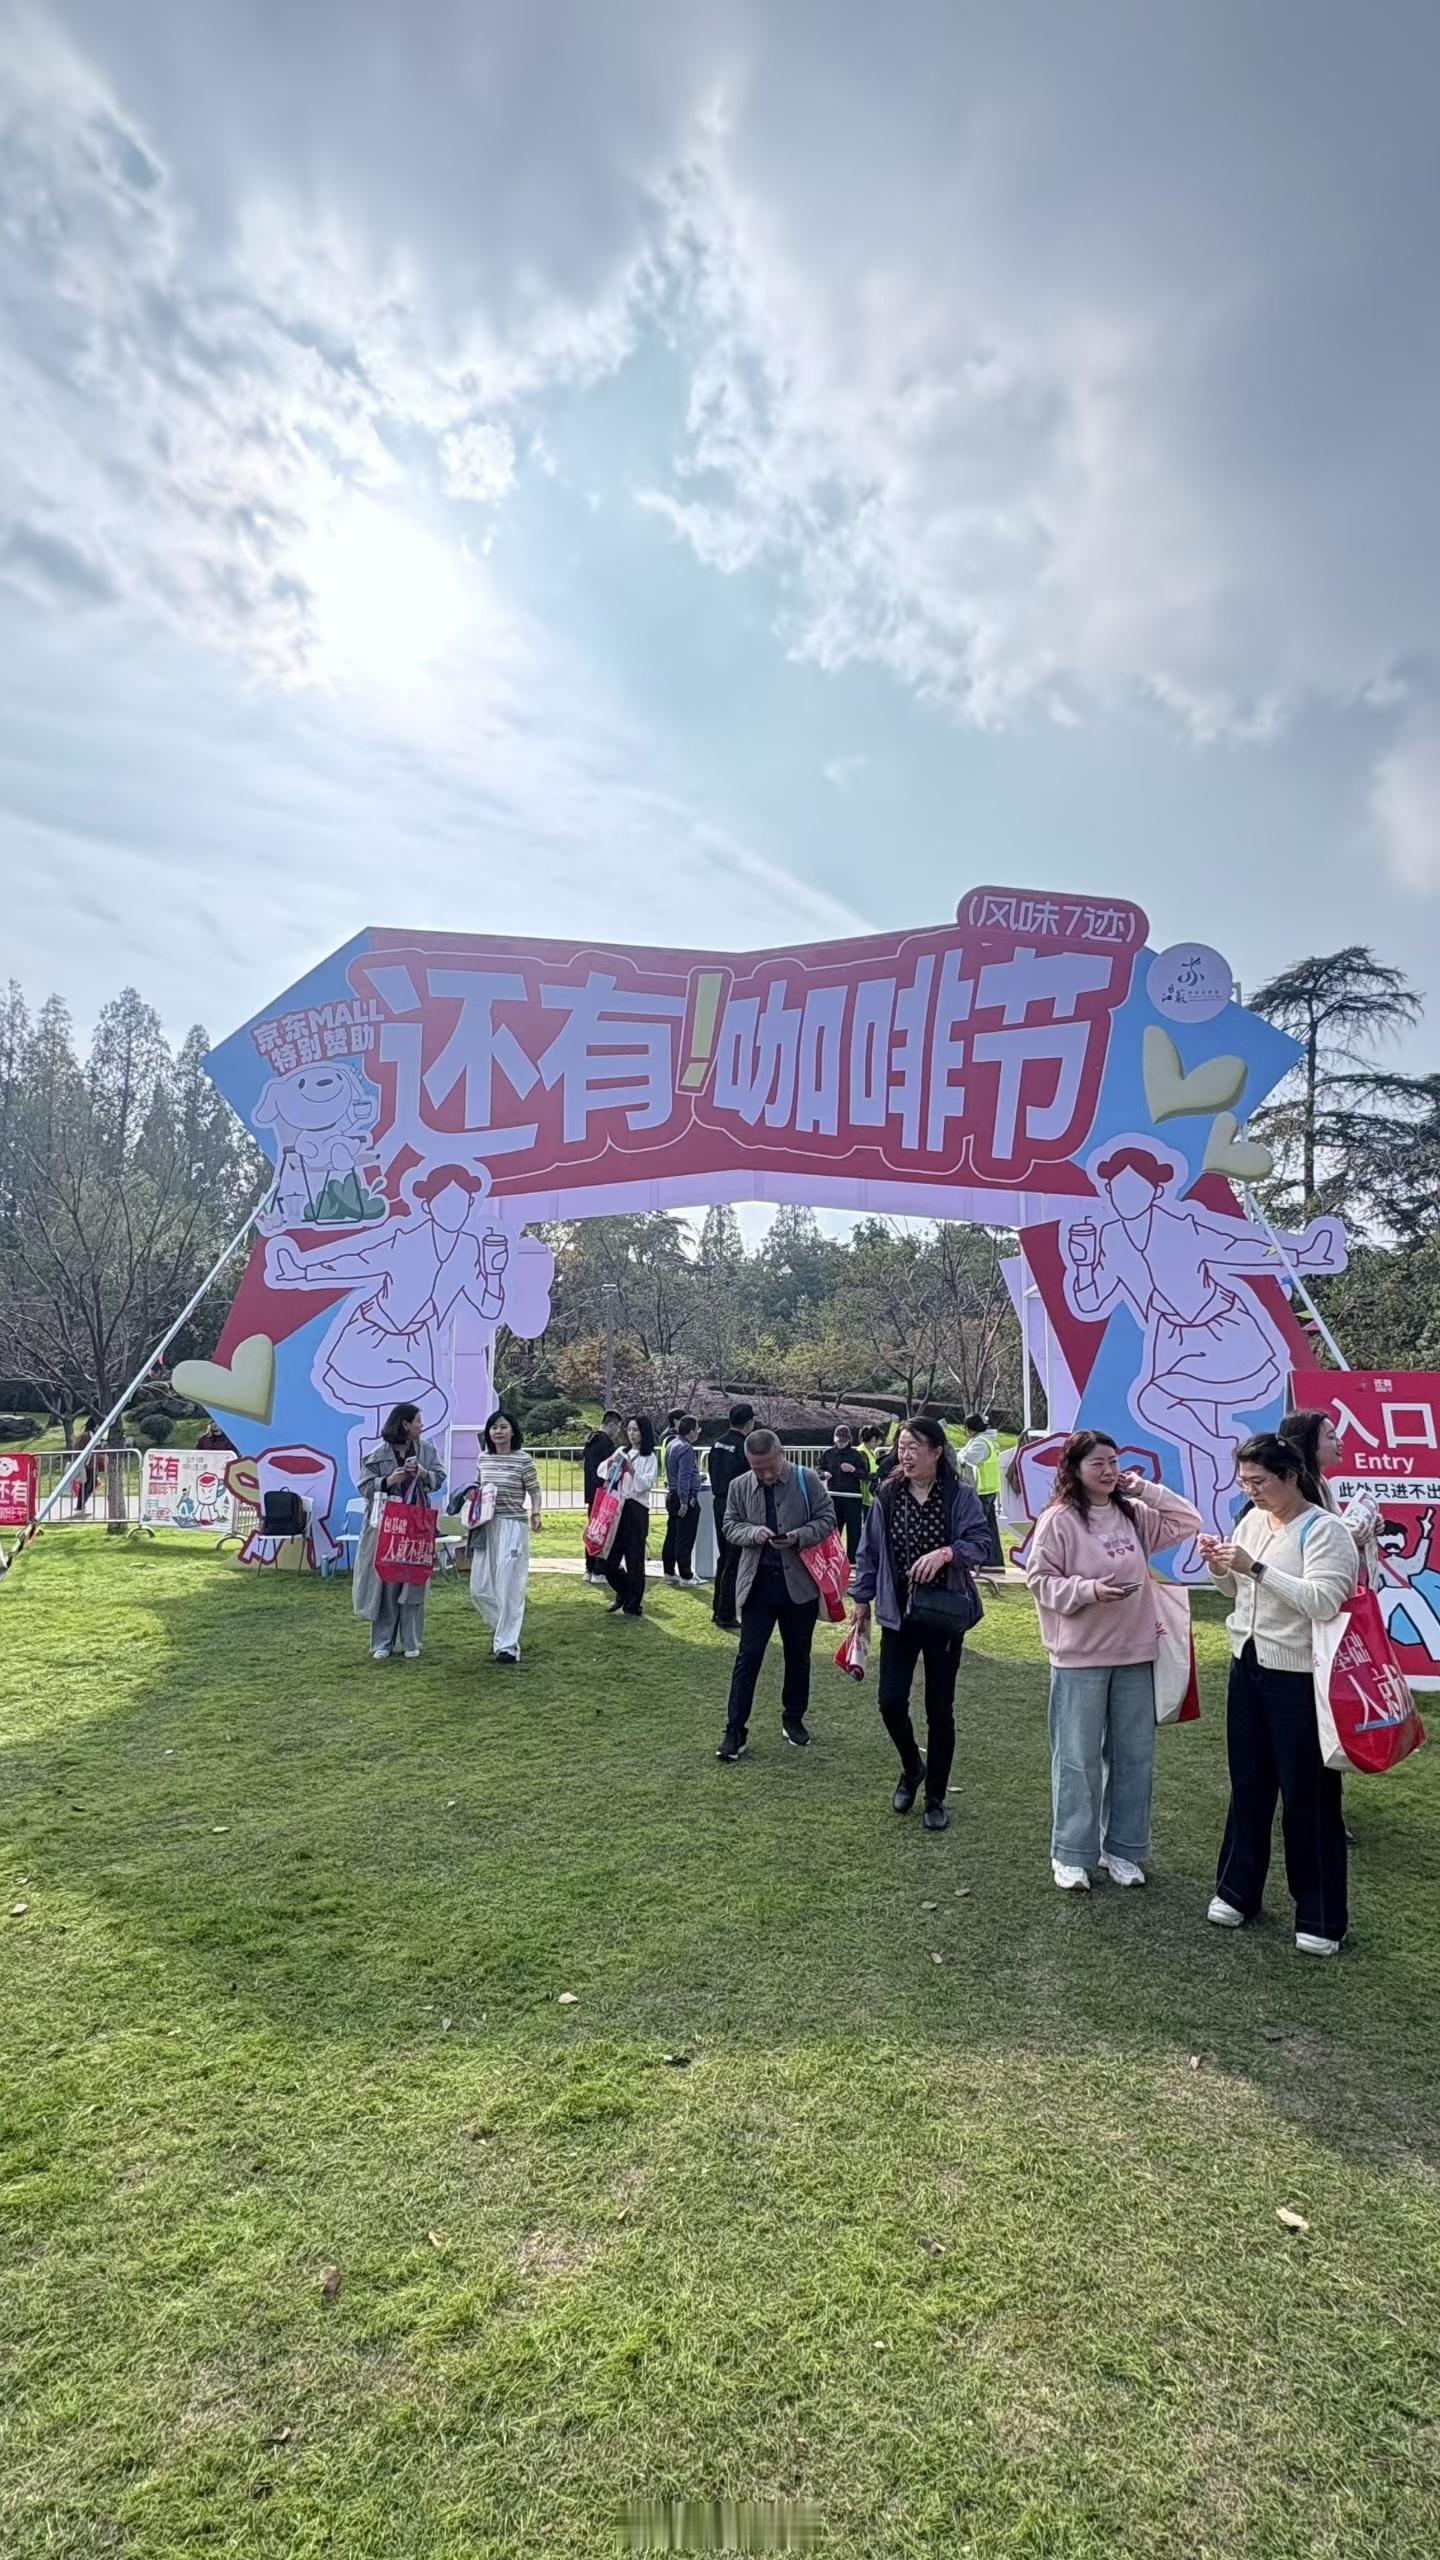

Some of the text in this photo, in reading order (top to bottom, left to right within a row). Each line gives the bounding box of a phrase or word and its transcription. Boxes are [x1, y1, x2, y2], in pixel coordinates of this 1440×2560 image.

[968, 895, 1136, 943] (风味7迹)
[253, 999, 385, 1054] 京东MALL
[271, 1024, 374, 1074] 特别赞助
[1331, 1397, 1438, 1449] 入口
[148, 1456, 180, 1481] 还有
[1354, 1452, 1414, 1474] Entry
